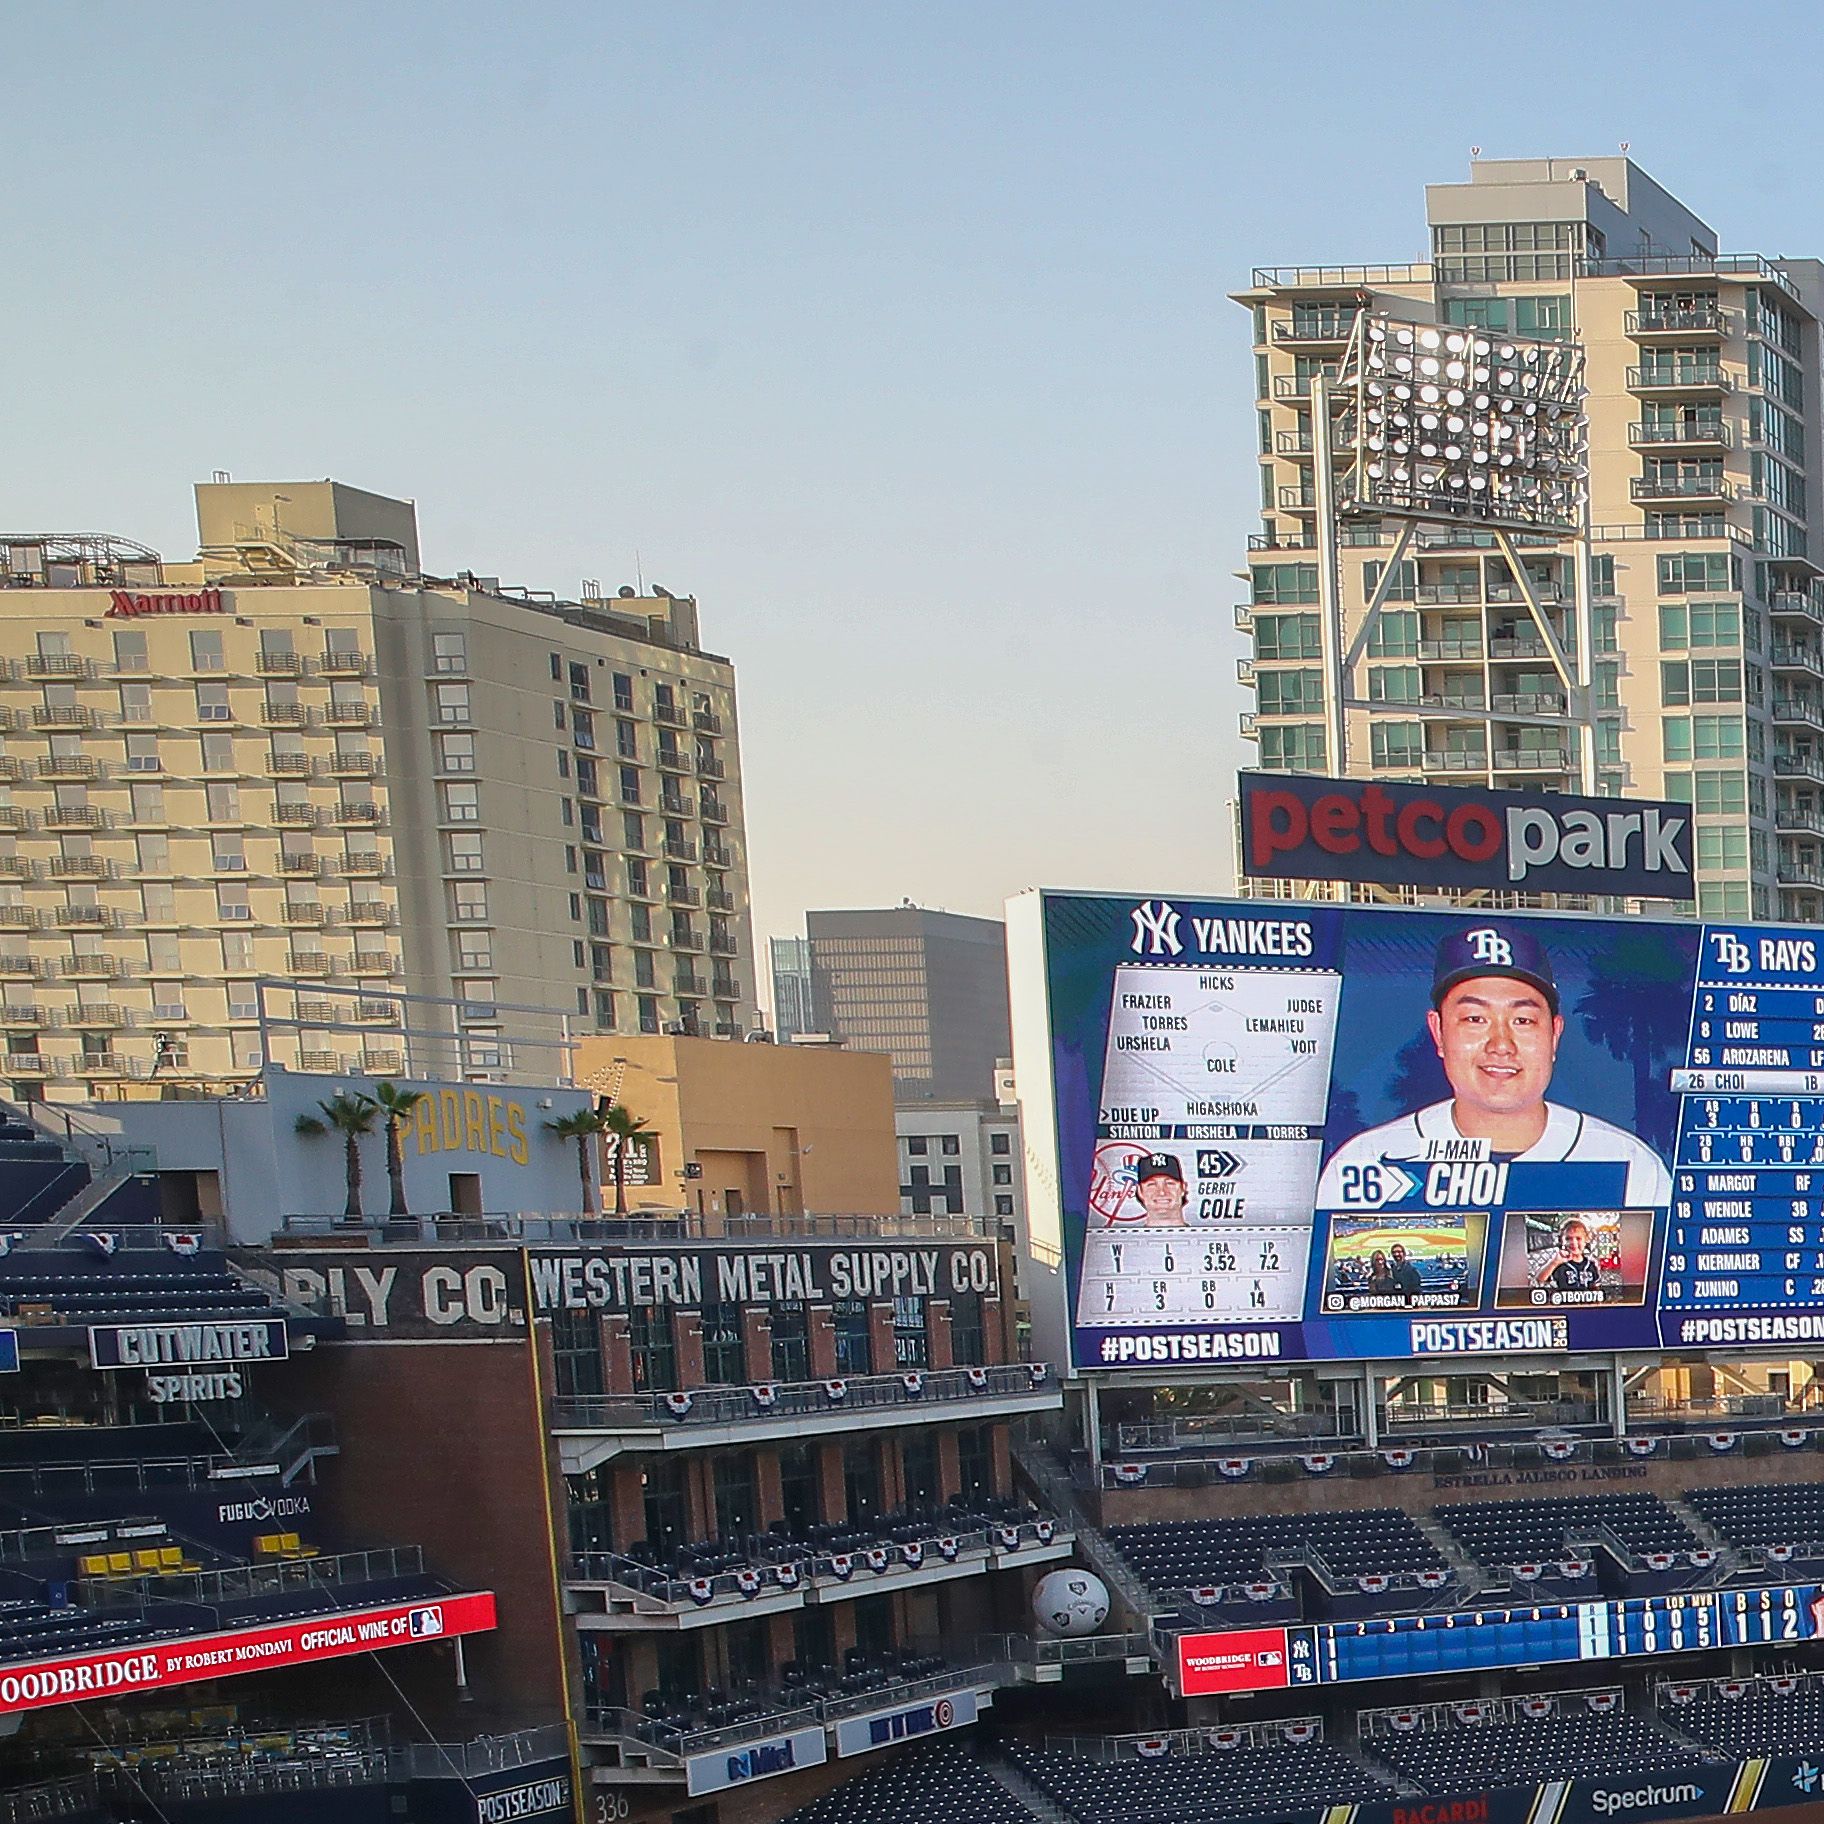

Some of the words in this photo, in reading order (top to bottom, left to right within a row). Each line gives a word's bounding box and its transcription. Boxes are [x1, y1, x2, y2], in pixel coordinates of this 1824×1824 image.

[104, 588, 222, 618] Marriott
[1249, 784, 1502, 867] petco
[1504, 804, 1690, 882] park
[1192, 918, 1313, 957] YANKEES
[1760, 939, 1817, 973] RAYS
[1200, 976, 1234, 991] HICKS
[1122, 995, 1171, 1009] FRAZIER
[1287, 999, 1323, 1014] JUDGE
[1729, 993, 1757, 1013] DÍAZ
[1143, 1016, 1187, 1031] TORRES
[1246, 1018, 1304, 1033] LEMAHIEU
[1725, 1022, 1759, 1039] LOWE
[1117, 1037, 1171, 1051] URSHELA
[1291, 1040, 1317, 1054] VOIT
[1207, 1058, 1236, 1073] COLE
[1722, 1049, 1790, 1066] AROZARENA
[1715, 1076, 1745, 1090] CHOI
[1111, 1108, 1137, 1123] DUE
[1141, 1108, 1160, 1123] UP
[1187, 1102, 1258, 1117] HIGASHIOKA
[1109, 1125, 1160, 1139] STANTON
[1187, 1125, 1237, 1139] URSHELA
[1266, 1125, 1308, 1139] TORRES
[1424, 1139, 1482, 1161] JI-MAN
[1198, 1182, 1236, 1195] GERRIT
[1341, 1164, 1382, 1204] 26
[1425, 1161, 1510, 1207] CHOI
[1707, 1175, 1757, 1192] MARGOT
[1199, 1199, 1244, 1220] COLE
[1703, 1201, 1752, 1218] WENDLE
[1701, 1228, 1749, 1244] ADAMES
[1209, 1242, 1229, 1254] ERA
[1203, 1255, 1236, 1272] 3.52
[1697, 1254, 1760, 1271] KIERMAIER
[530, 1255, 702, 1309] WESTERN
[717, 1252, 825, 1302] METAL
[829, 1250, 939, 1298] SUPPLY
[950, 1249, 996, 1294] CO.
[421, 1265, 525, 1326] CO.
[1694, 1281, 1739, 1298] ZUNINO
[117, 1324, 271, 1365] CUTWATER
[1410, 1320, 1553, 1352] POSTSEASON
[1101, 1331, 1281, 1362] #POSTSEASON
[150, 1371, 243, 1403] SPIRITS
[1434, 1472, 1512, 1489] ESTRELLA
[1516, 1469, 1577, 1485] JALISCO
[166, 1657, 184, 1673] BY
[185, 1648, 234, 1670] ROBERT
[235, 1639, 293, 1662] MONDAVI
[300, 1627, 356, 1652] OFFICIAL
[358, 1620, 390, 1642] WINE
[392, 1617, 408, 1635] OF
[1186, 1652, 1252, 1669] WOODBRIDGE
[477, 1779, 562, 1824] POSTSEASON
[1592, 1781, 1699, 1816] Spectrum
